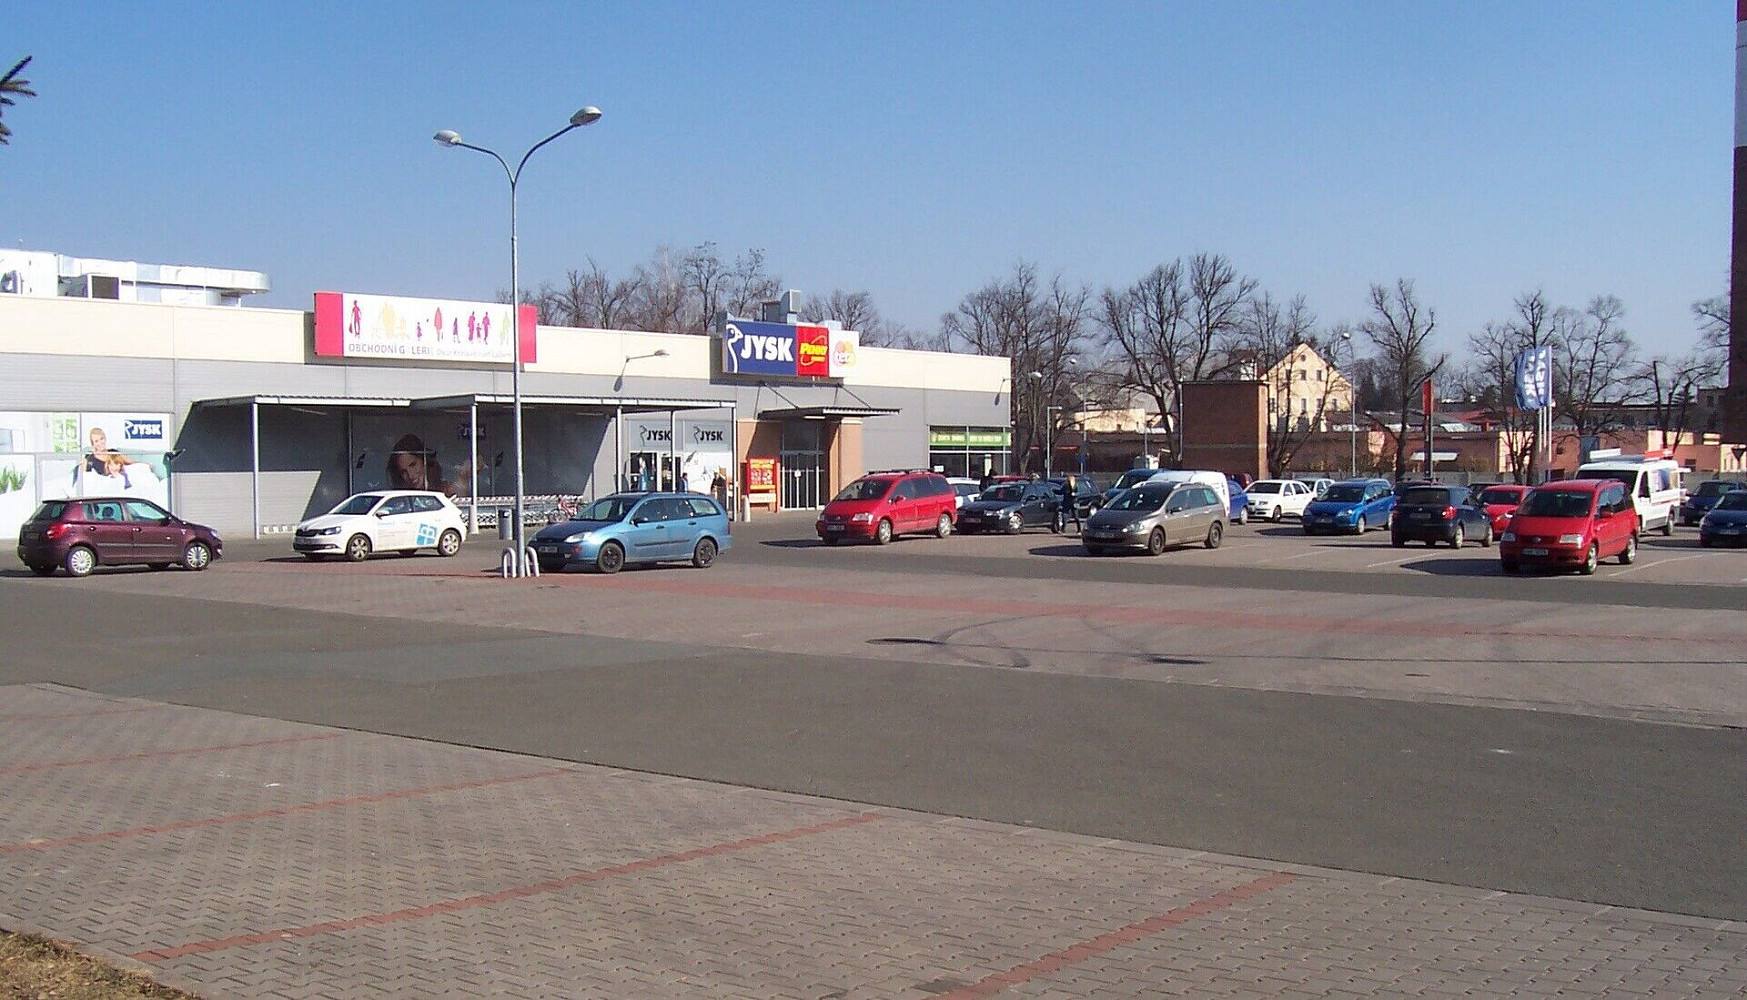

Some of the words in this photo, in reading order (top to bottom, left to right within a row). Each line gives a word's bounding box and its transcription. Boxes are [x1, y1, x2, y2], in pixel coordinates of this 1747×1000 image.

[740, 335, 794, 362] JYSK
[131, 423, 162, 435] JYSK
[646, 430, 672, 441] JYSK
[699, 430, 724, 441] JYSK
